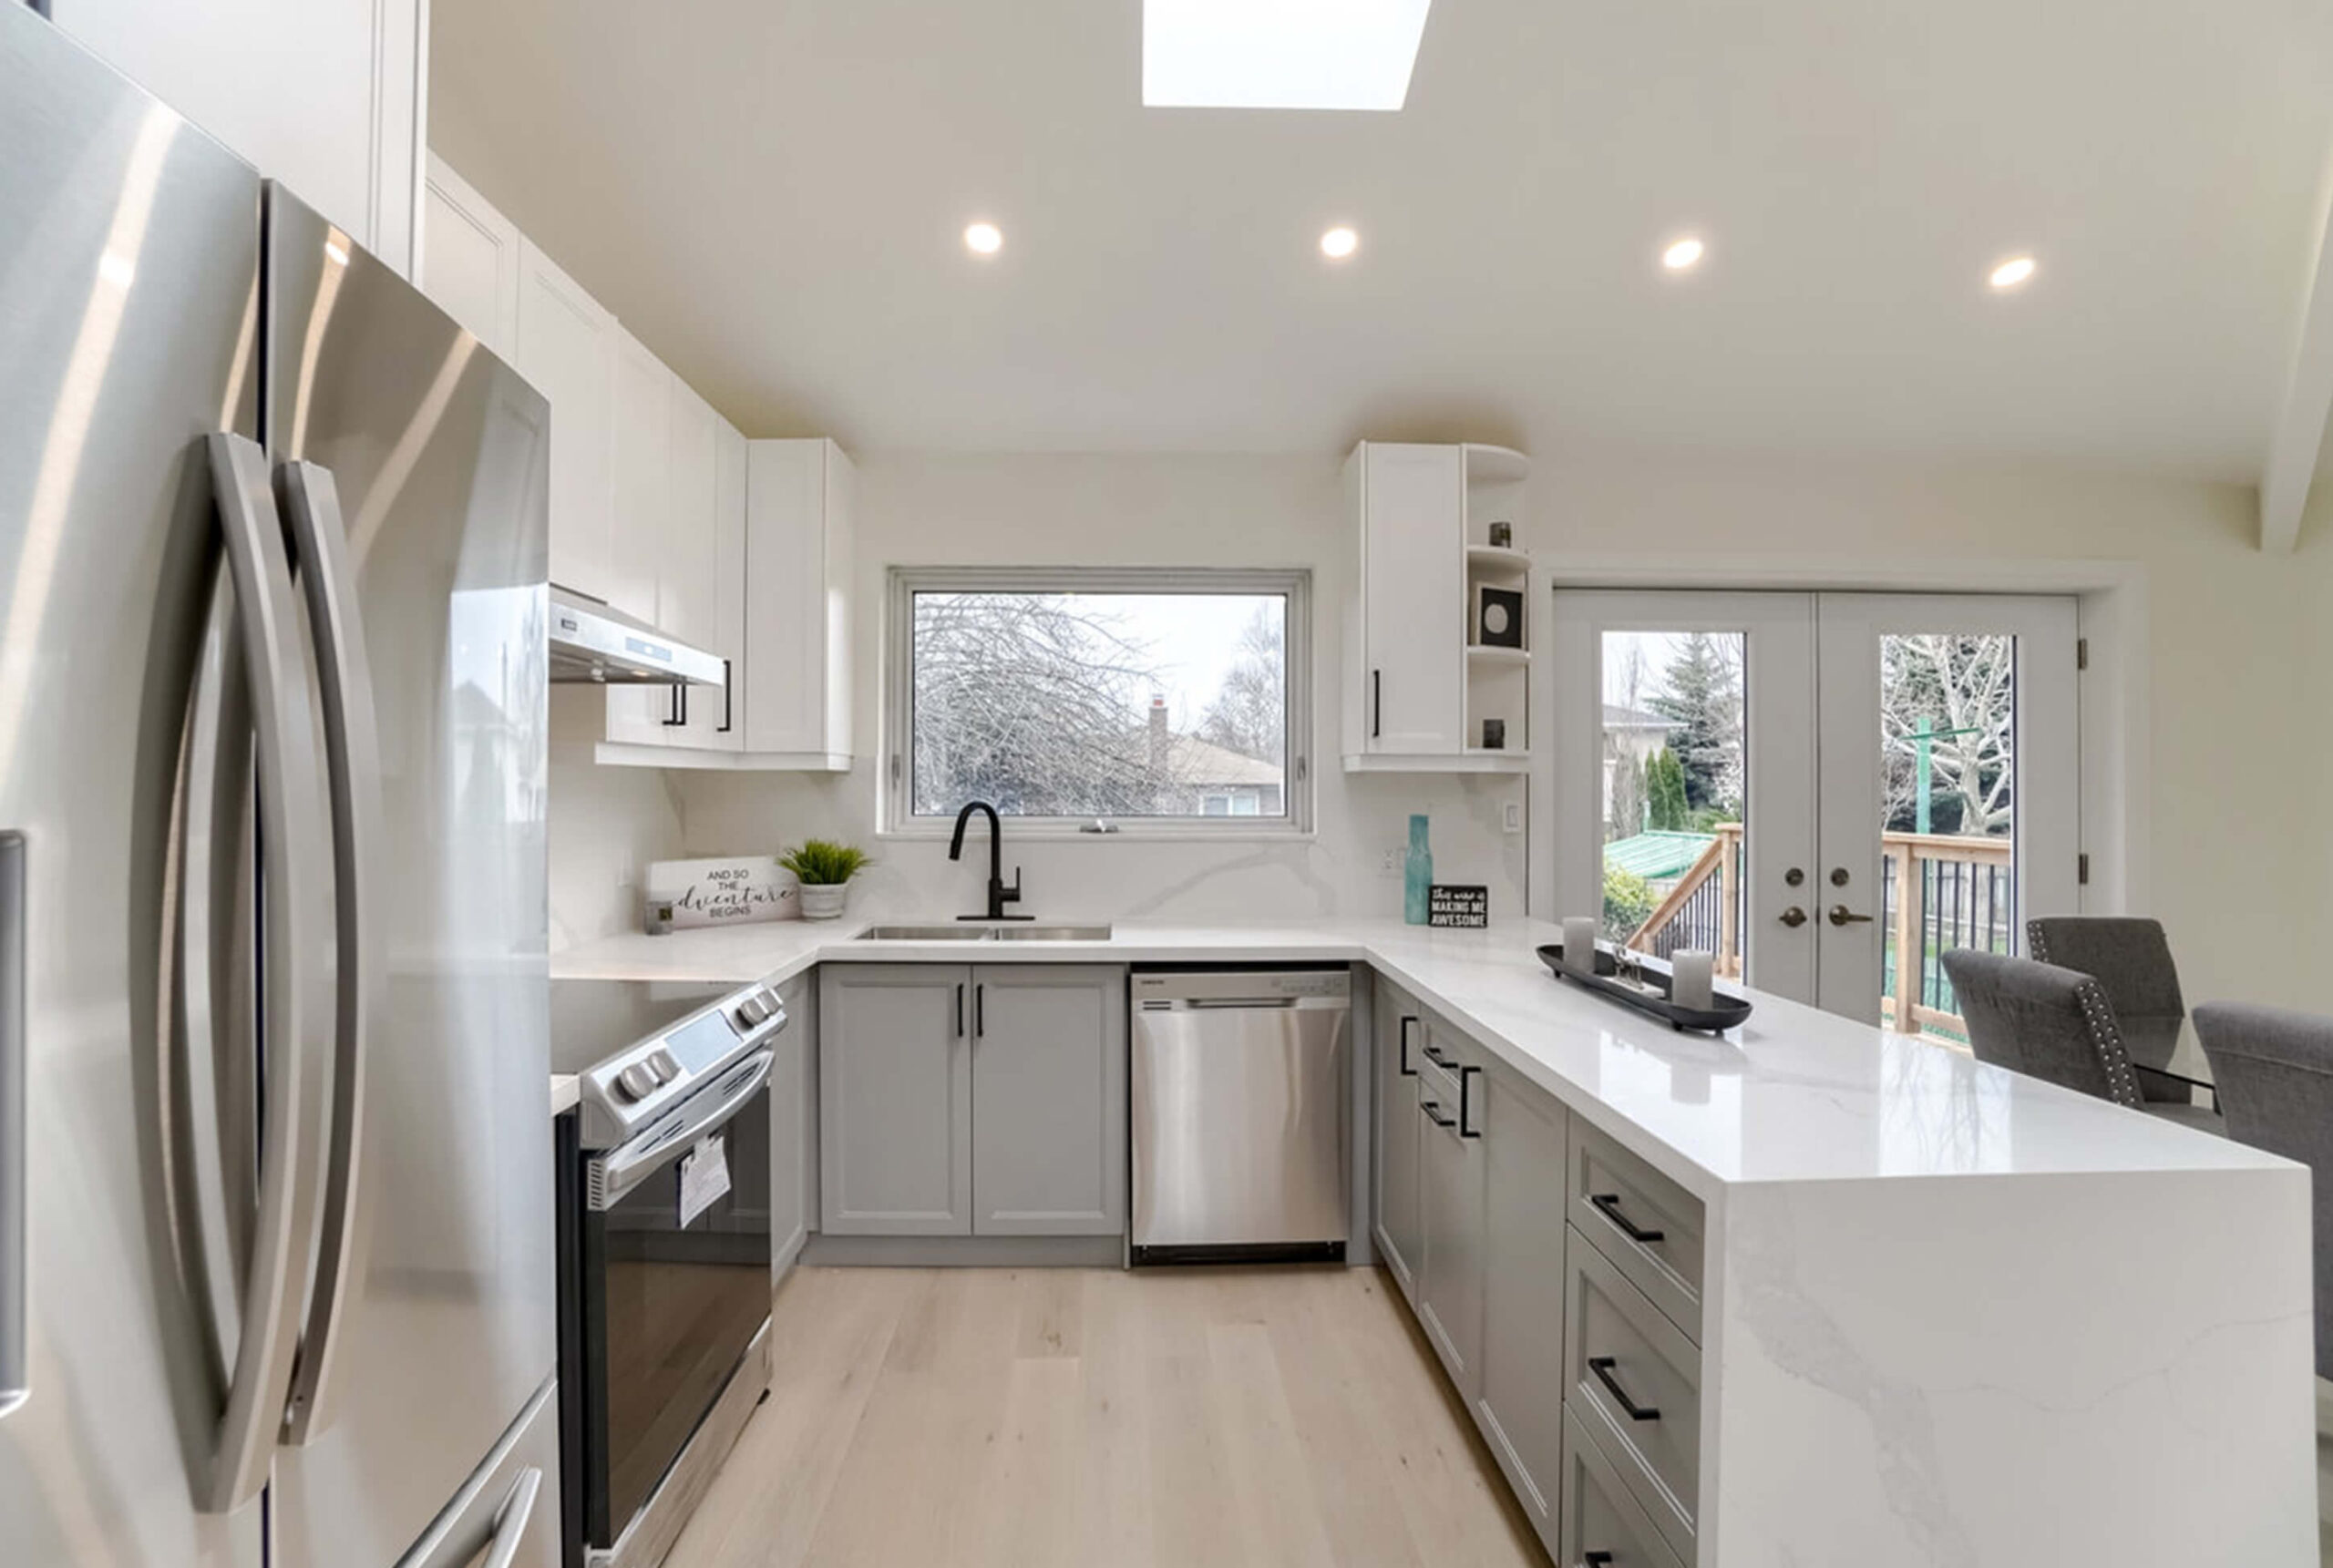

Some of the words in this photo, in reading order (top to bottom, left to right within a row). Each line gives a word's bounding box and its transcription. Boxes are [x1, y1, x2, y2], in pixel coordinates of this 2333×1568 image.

[707, 870, 731, 880] AND
[733, 869, 749, 879] SO
[718, 881, 739, 891] THE
[673, 884, 797, 912] dventure
[709, 906, 752, 918] BEGINS
[1432, 901, 1469, 912] MAKING
[1472, 901, 1485, 913] ME
[1432, 914, 1485, 927] AWESOME
